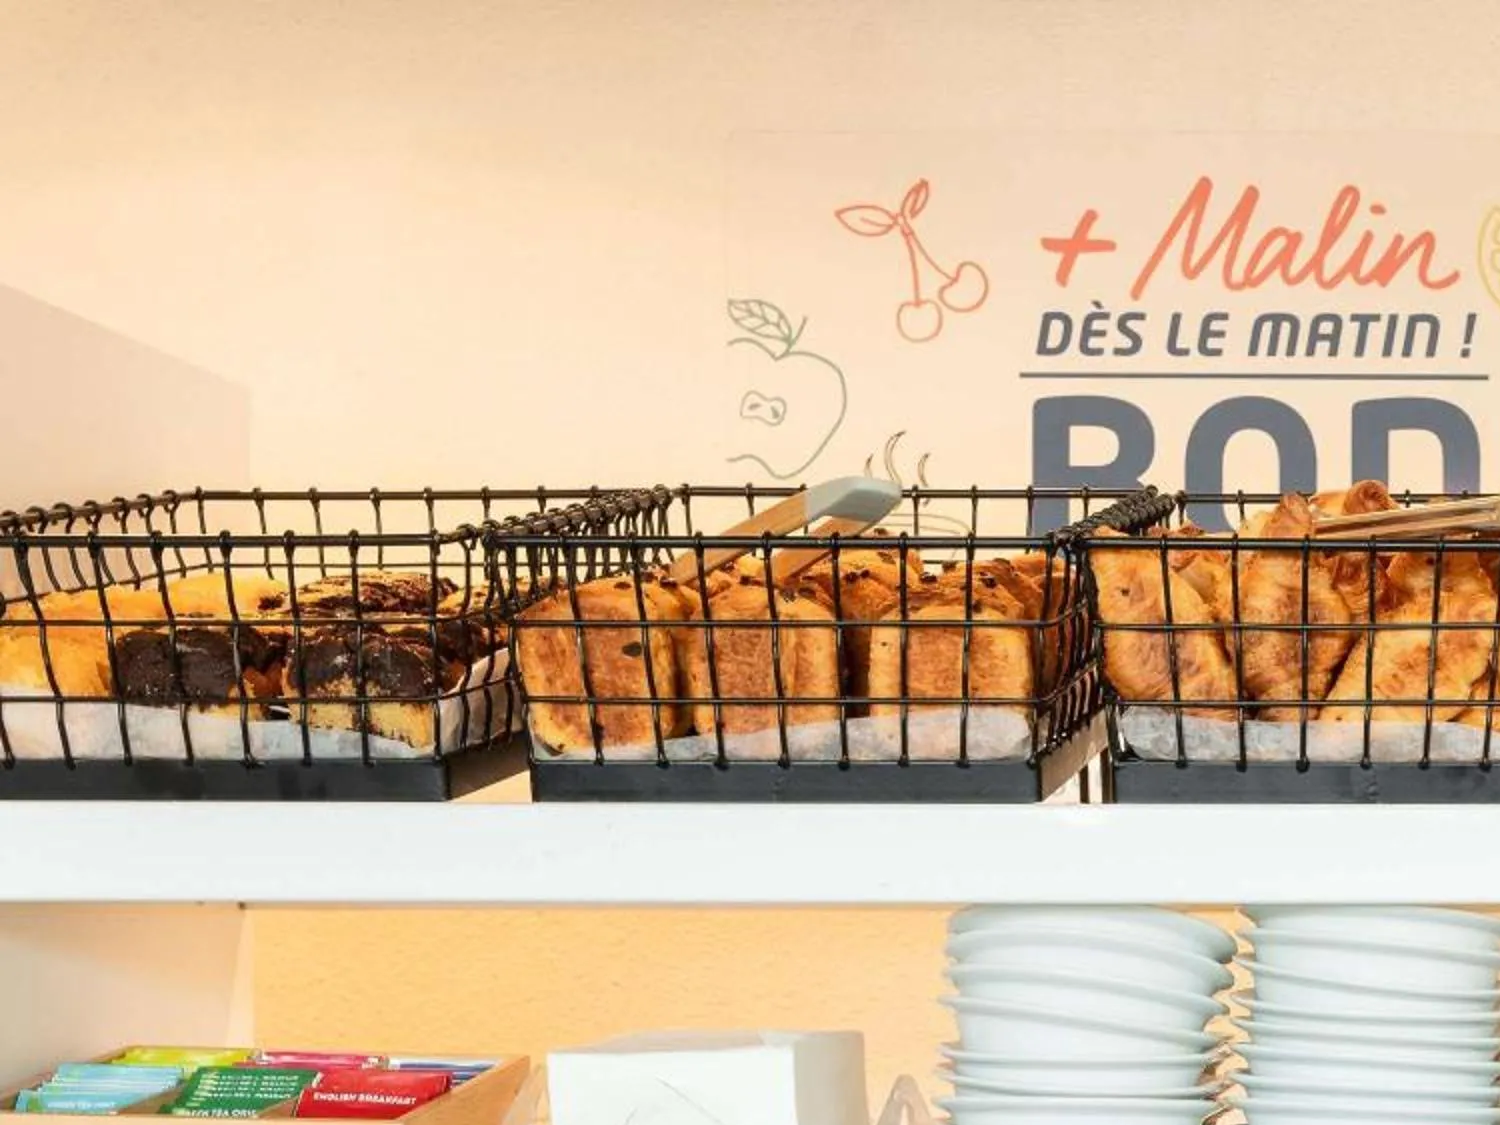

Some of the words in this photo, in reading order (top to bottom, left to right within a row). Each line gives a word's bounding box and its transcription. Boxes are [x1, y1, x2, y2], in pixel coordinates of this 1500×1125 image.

[1129, 175, 1461, 302] Malin
[1035, 299, 1148, 358] DÈS
[1165, 311, 1230, 358] LE
[1246, 312, 1442, 359] MATIN
[1458, 312, 1478, 359] !
